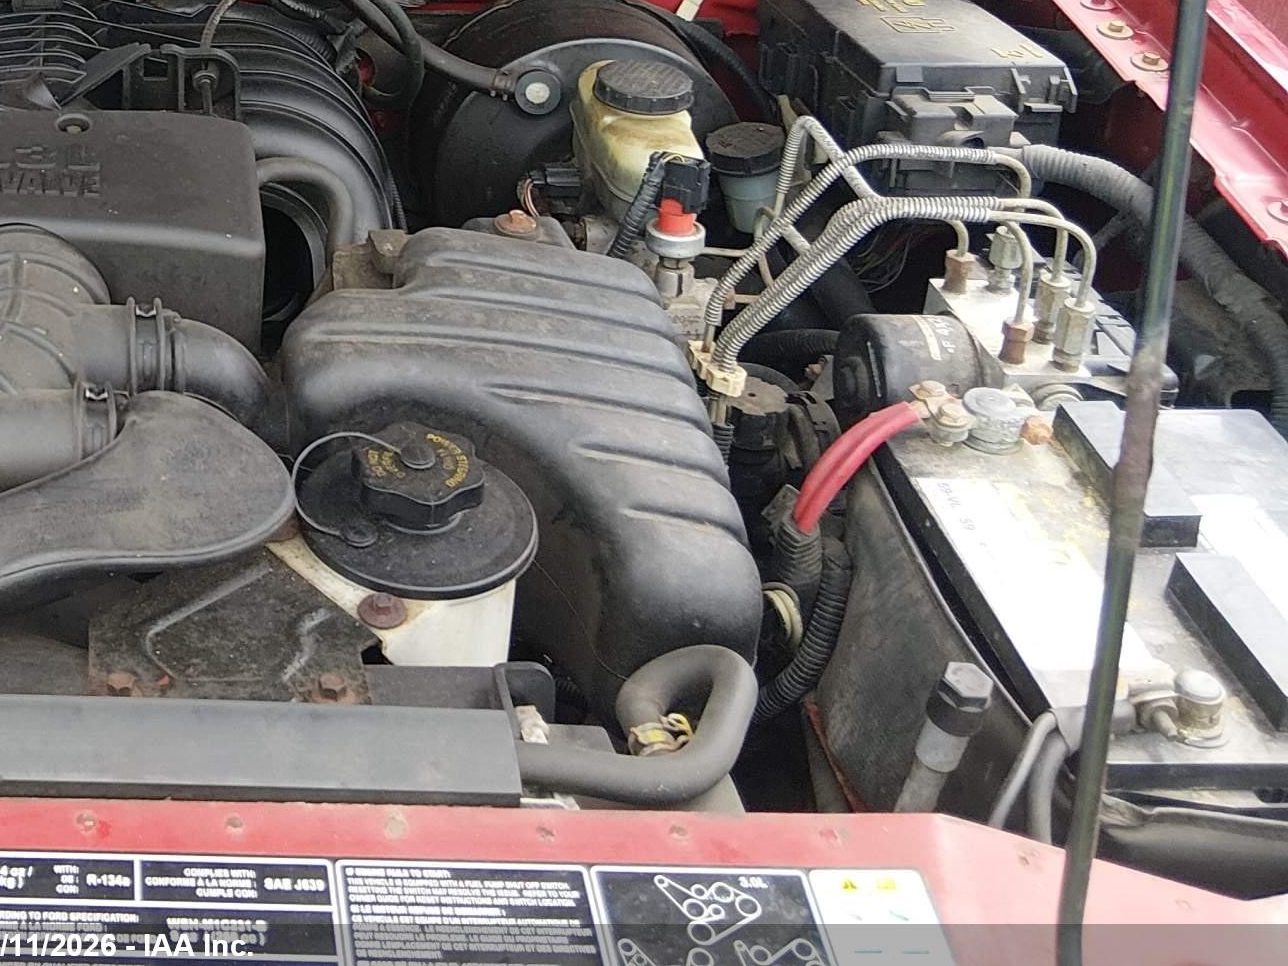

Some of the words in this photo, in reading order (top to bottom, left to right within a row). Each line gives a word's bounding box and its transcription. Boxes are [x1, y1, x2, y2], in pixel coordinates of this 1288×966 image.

[426, 433, 463, 454] POWER
[86, 873, 130, 888] R-134a
[263, 877, 291, 891] SAE
[294, 878, 325, 892] J639
